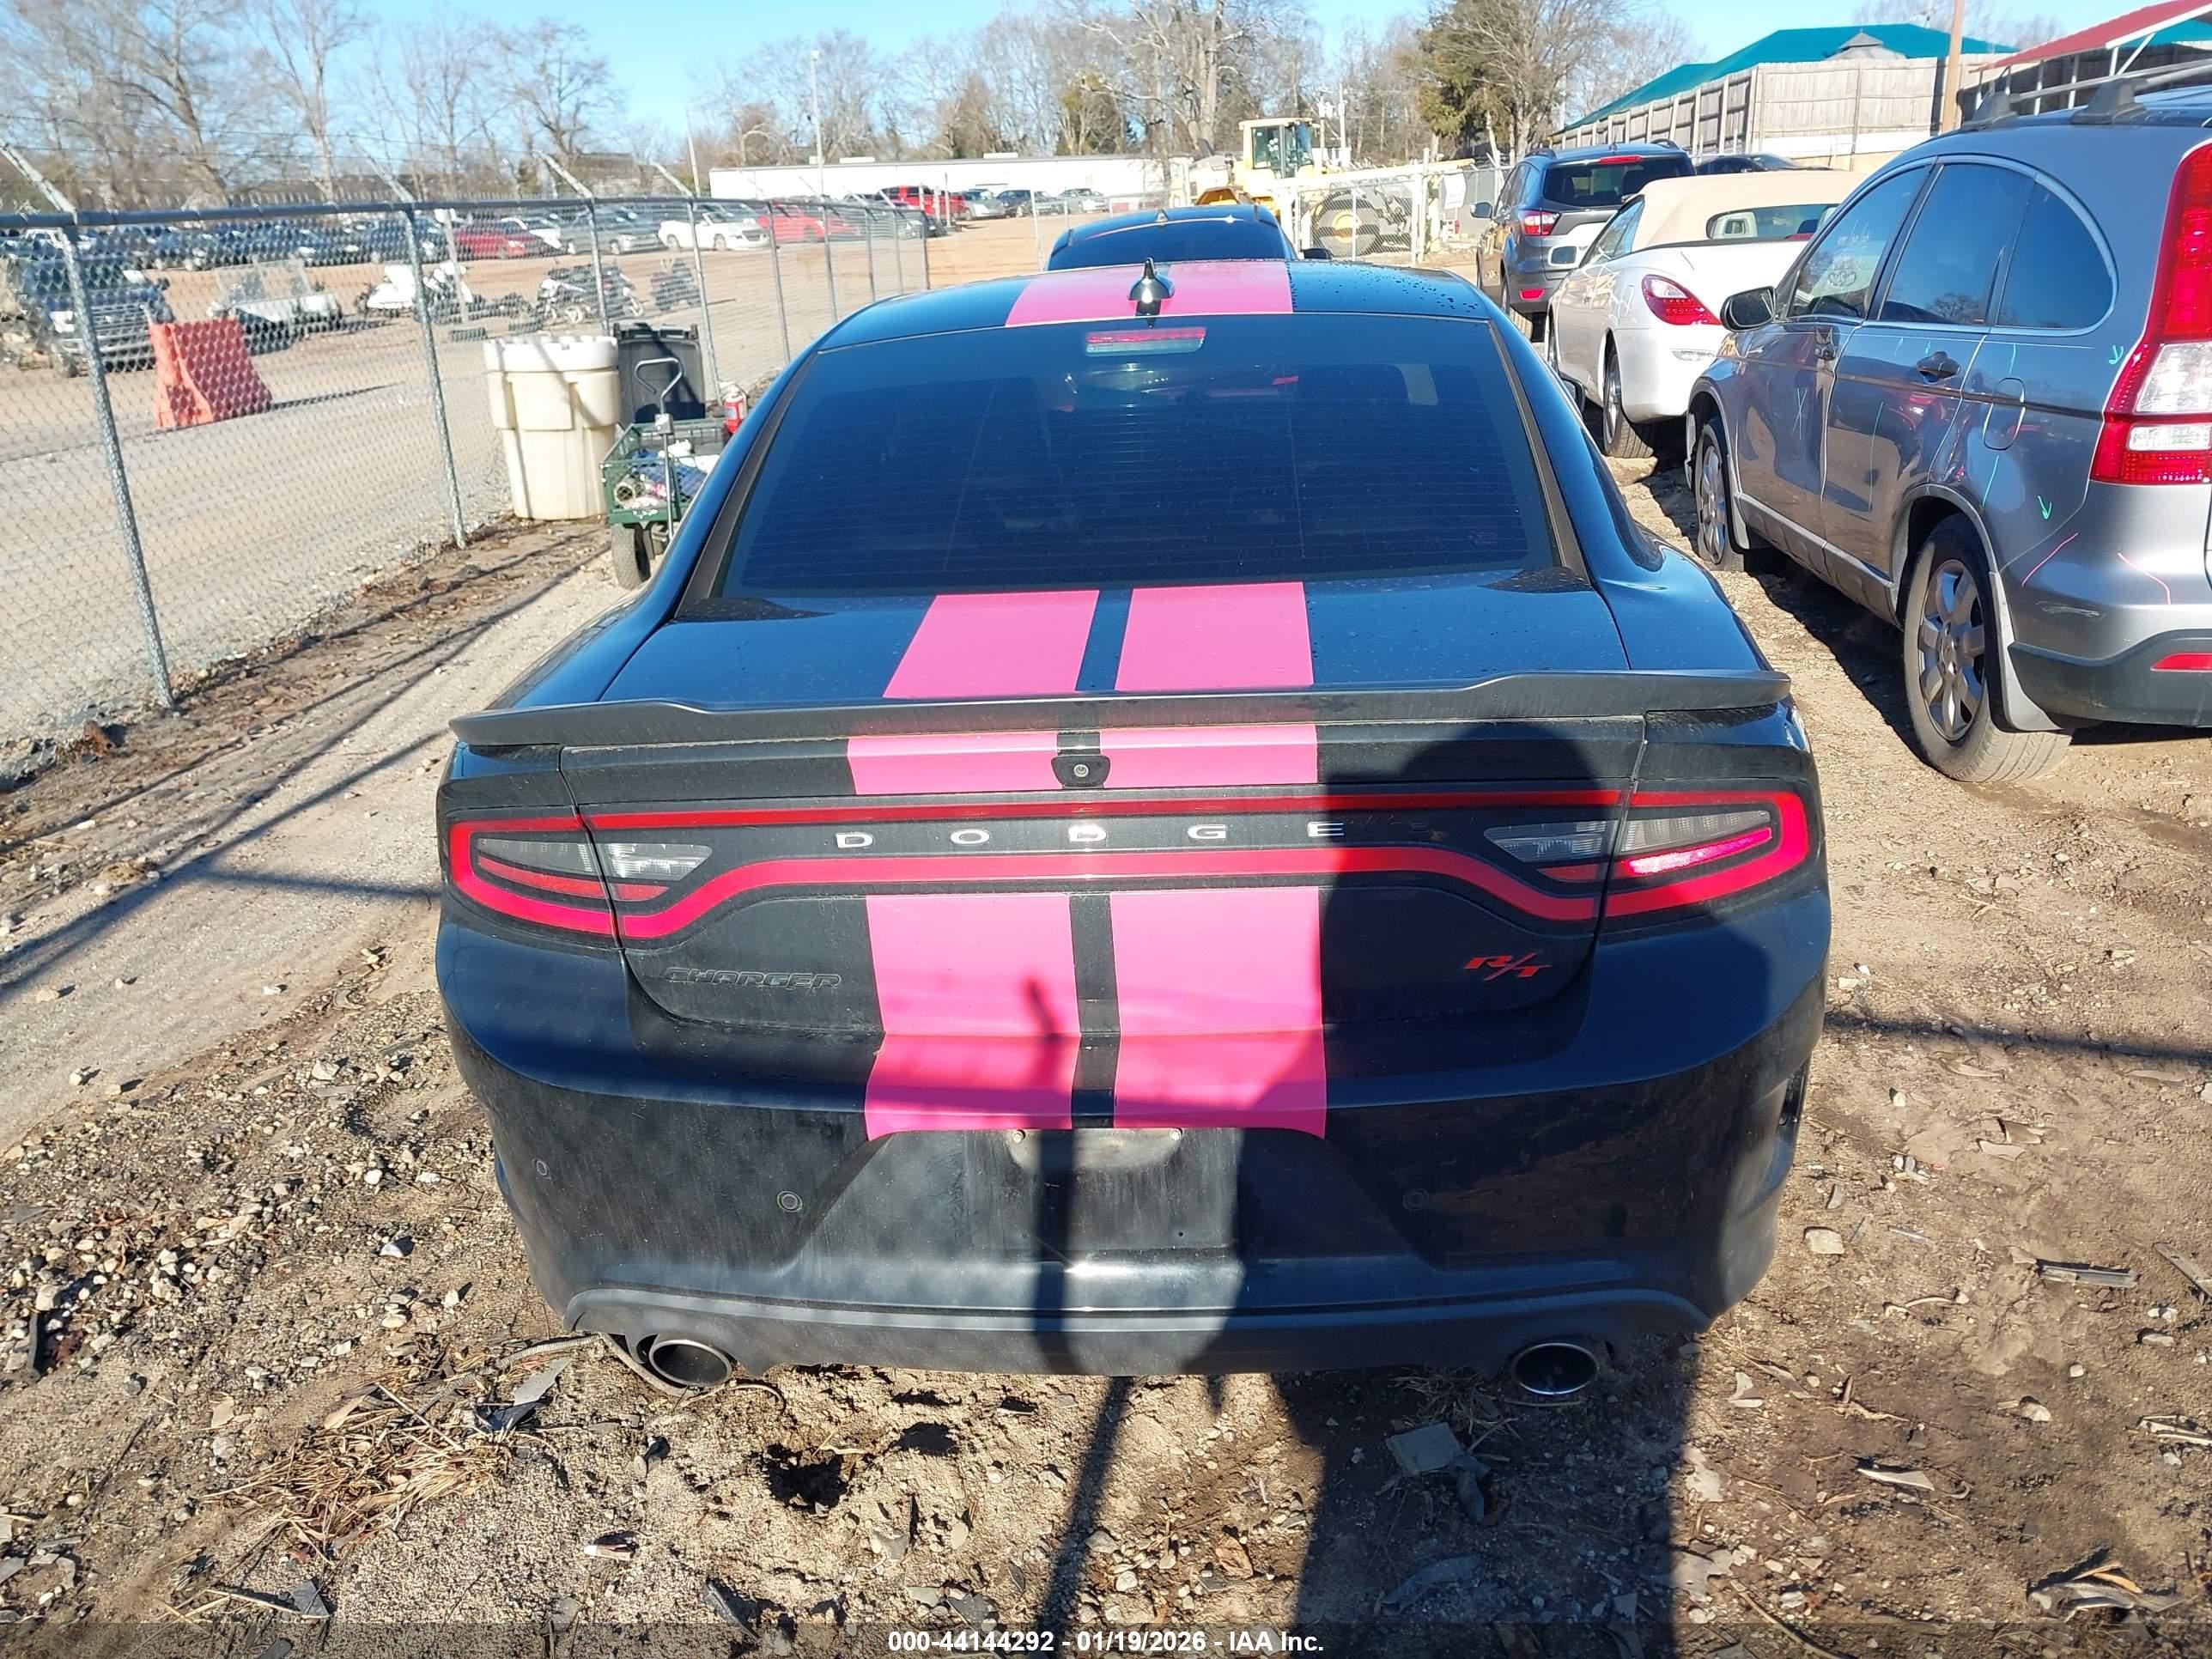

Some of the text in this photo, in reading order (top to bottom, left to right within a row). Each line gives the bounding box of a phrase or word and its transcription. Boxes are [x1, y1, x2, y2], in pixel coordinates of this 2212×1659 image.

[835, 821, 1345, 849] DODGE
[665, 967, 842, 988] CHARGER
[1463, 951, 1553, 981] R/T
